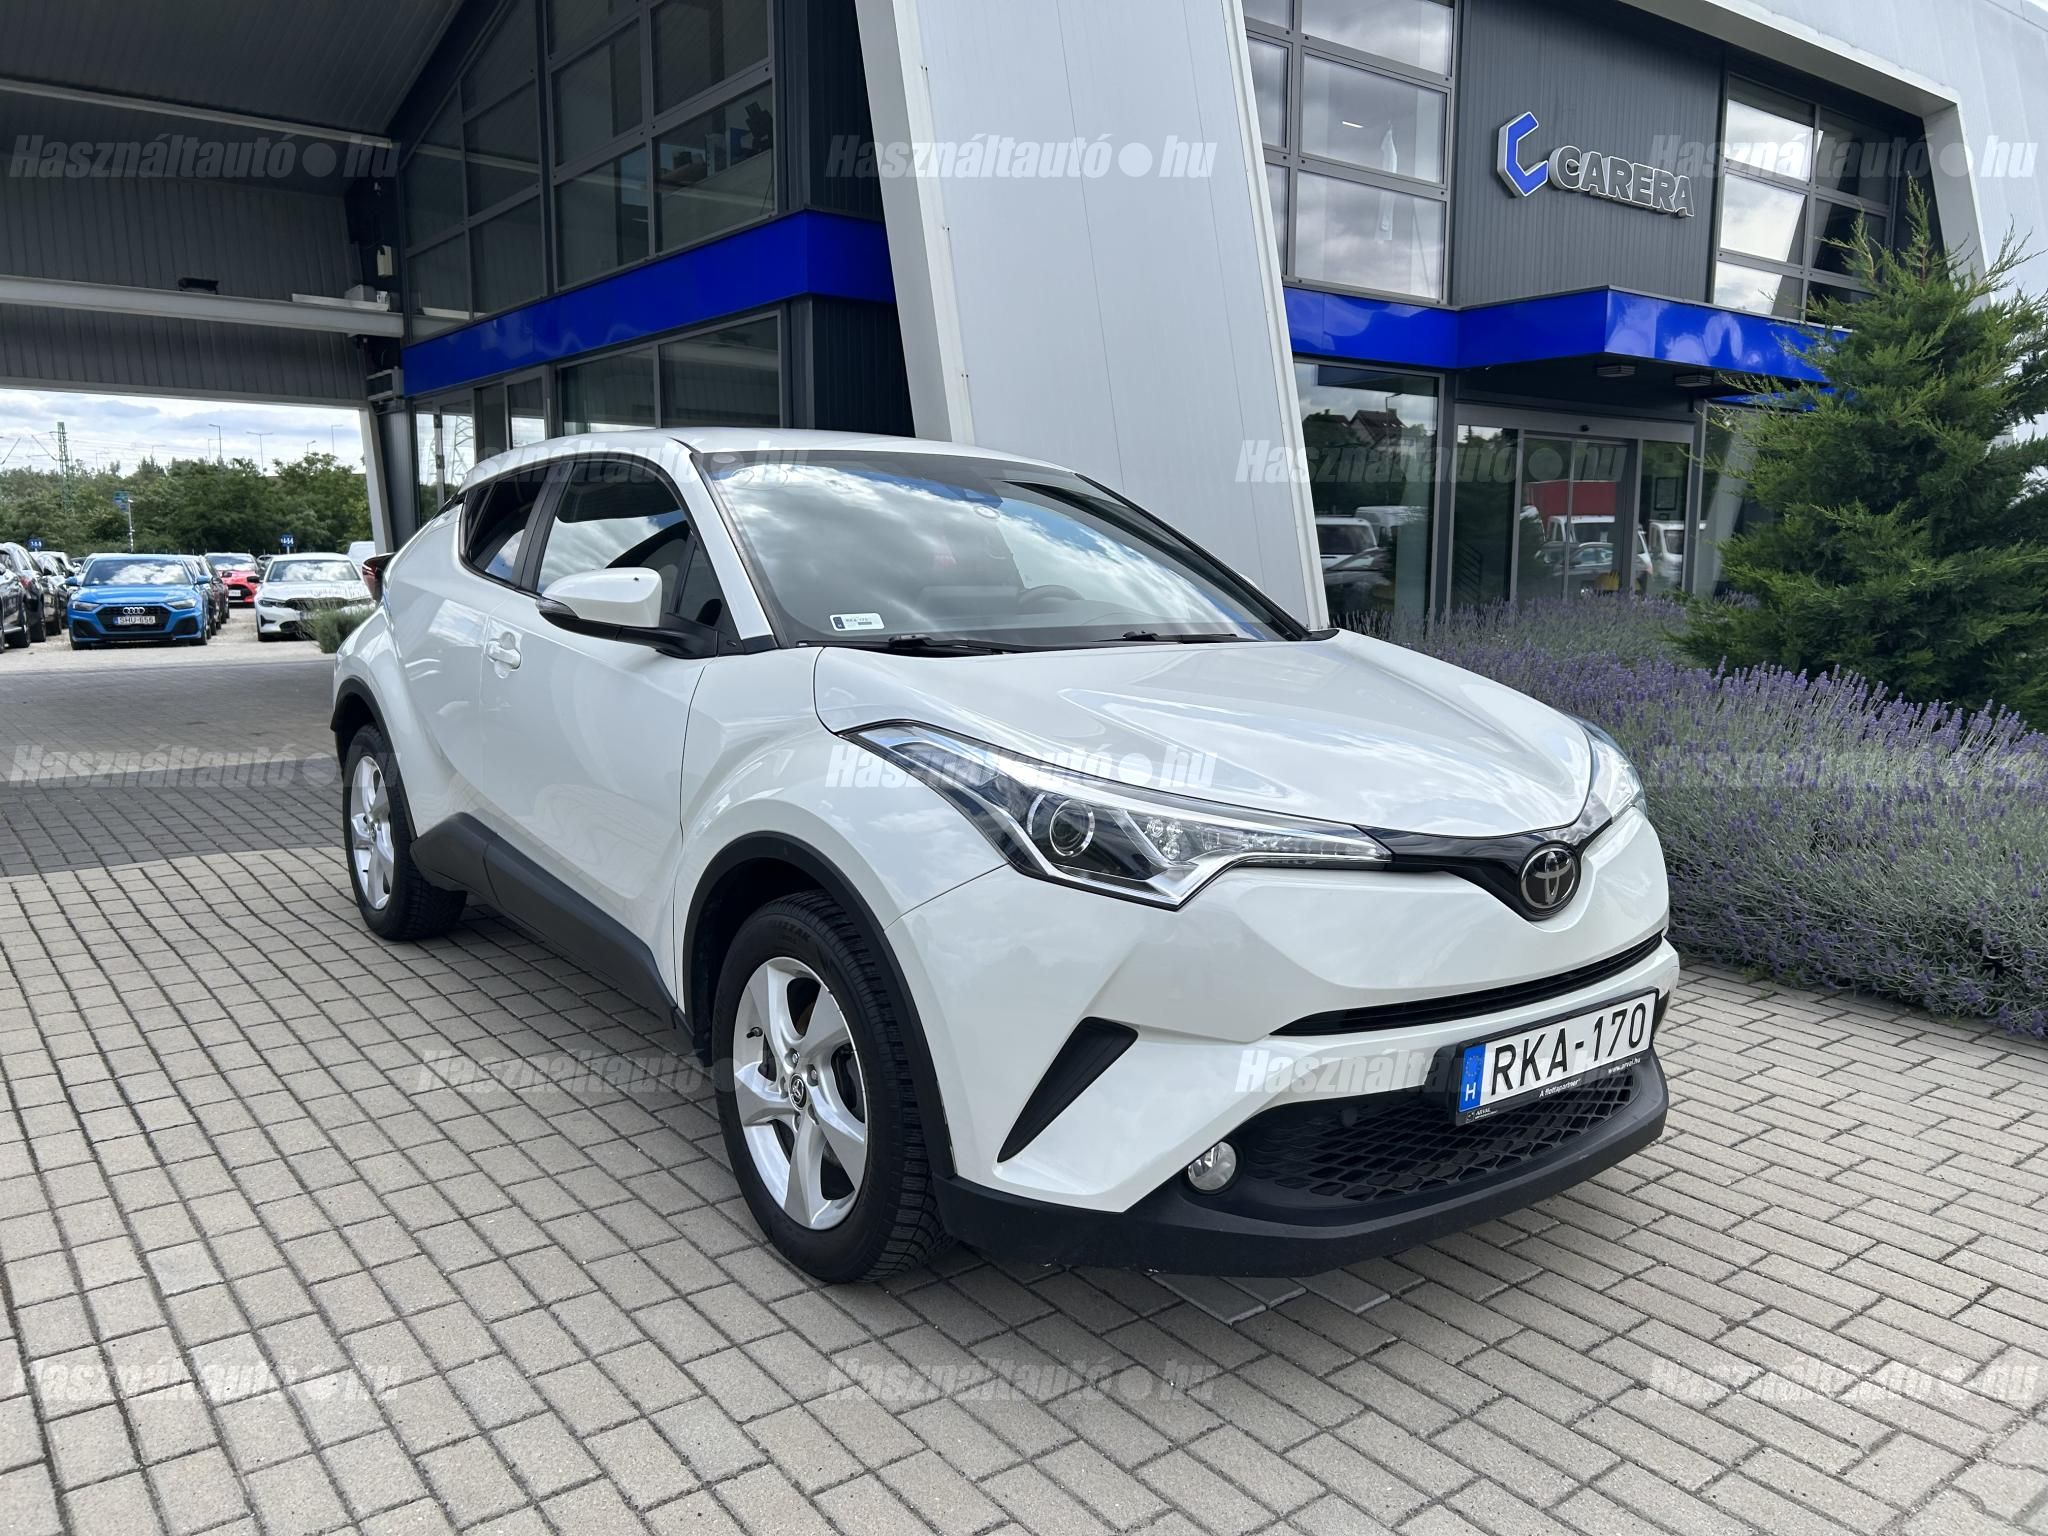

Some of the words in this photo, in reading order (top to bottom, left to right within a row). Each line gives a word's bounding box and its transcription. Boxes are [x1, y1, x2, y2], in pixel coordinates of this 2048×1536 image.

[1551, 145, 1695, 217] CARERA
[1491, 1003, 1647, 1096] RKA-170
[1465, 1082, 1477, 1102] H
